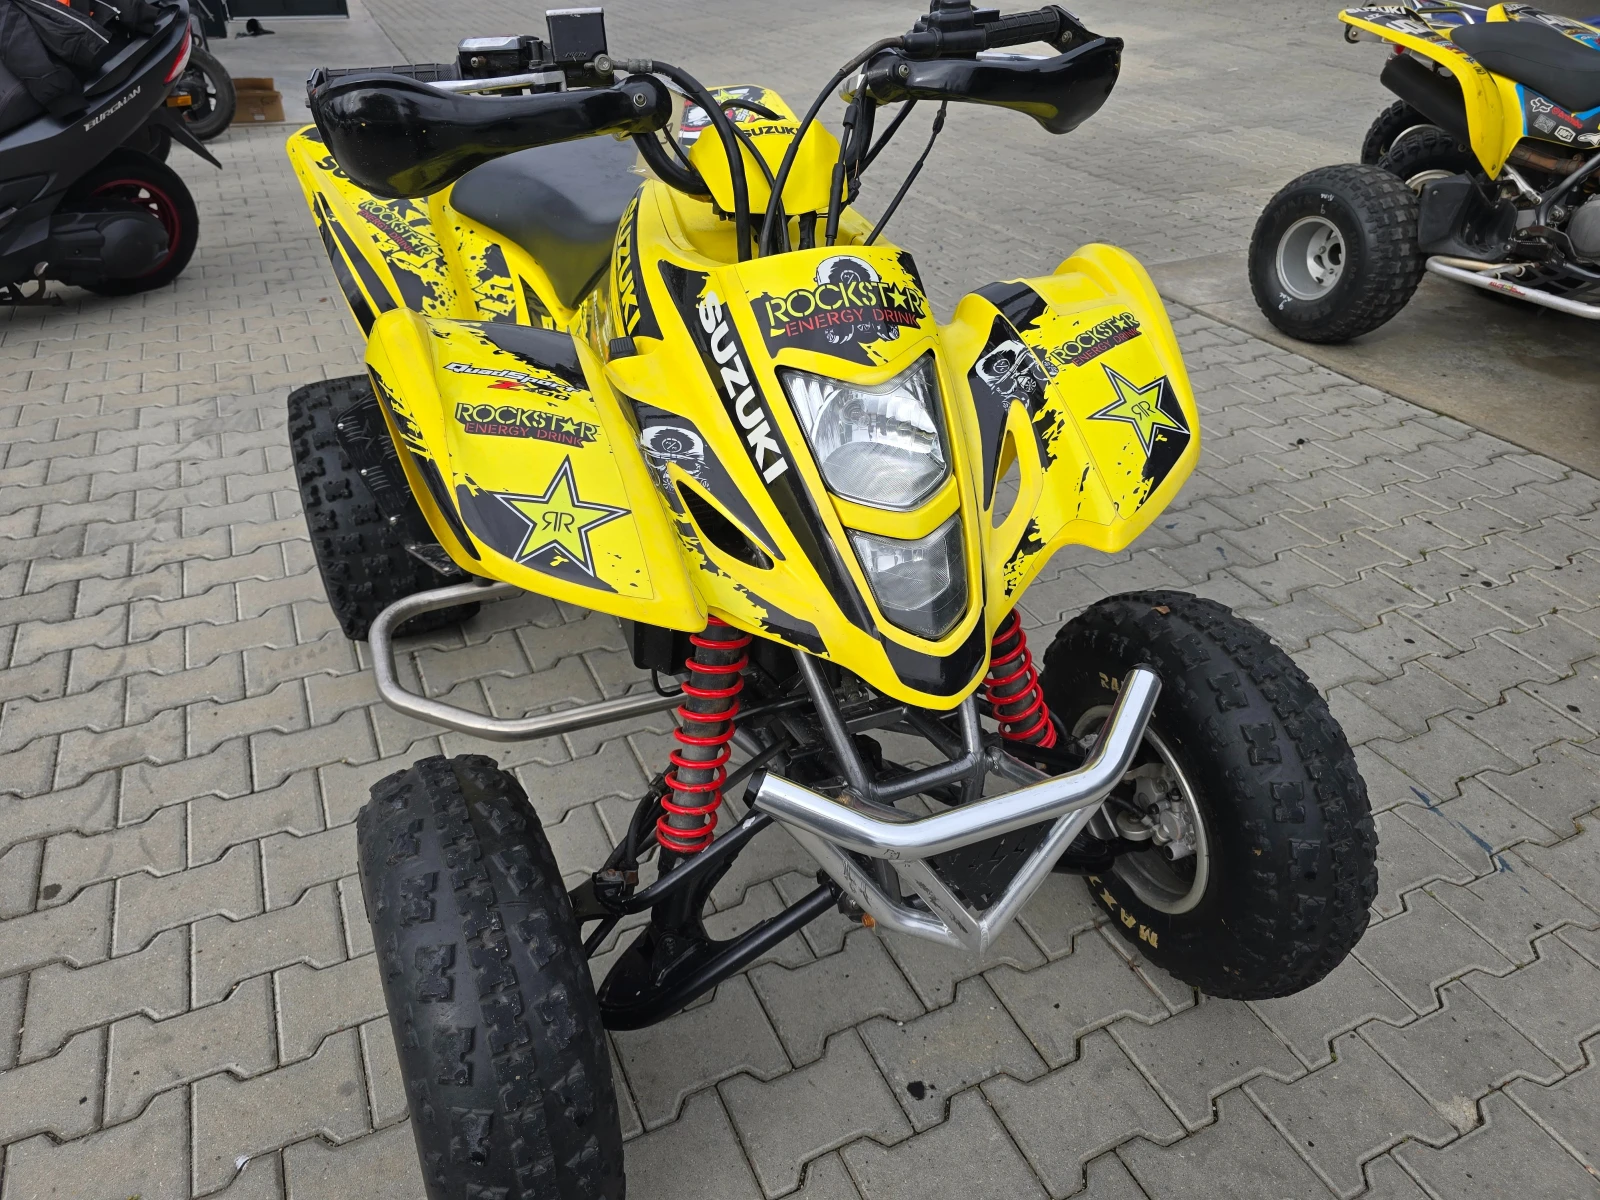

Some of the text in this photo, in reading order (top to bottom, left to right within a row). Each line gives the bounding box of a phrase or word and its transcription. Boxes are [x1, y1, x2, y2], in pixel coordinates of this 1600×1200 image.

[1346, 6, 1406, 15] SUZUKI
[83, 85, 141, 132] BURGMAN
[359, 208, 414, 254] ENERGY DRINK
[617, 197, 641, 337] SUZUKI
[785, 308, 918, 337] ENERGY DRINK
[1072, 327, 1141, 366] ENERGY DRINK
[444, 362, 580, 393] QuadSport
[698, 290, 789, 485] SUZUKI
[465, 422, 584, 447] ENERGY DRINK
